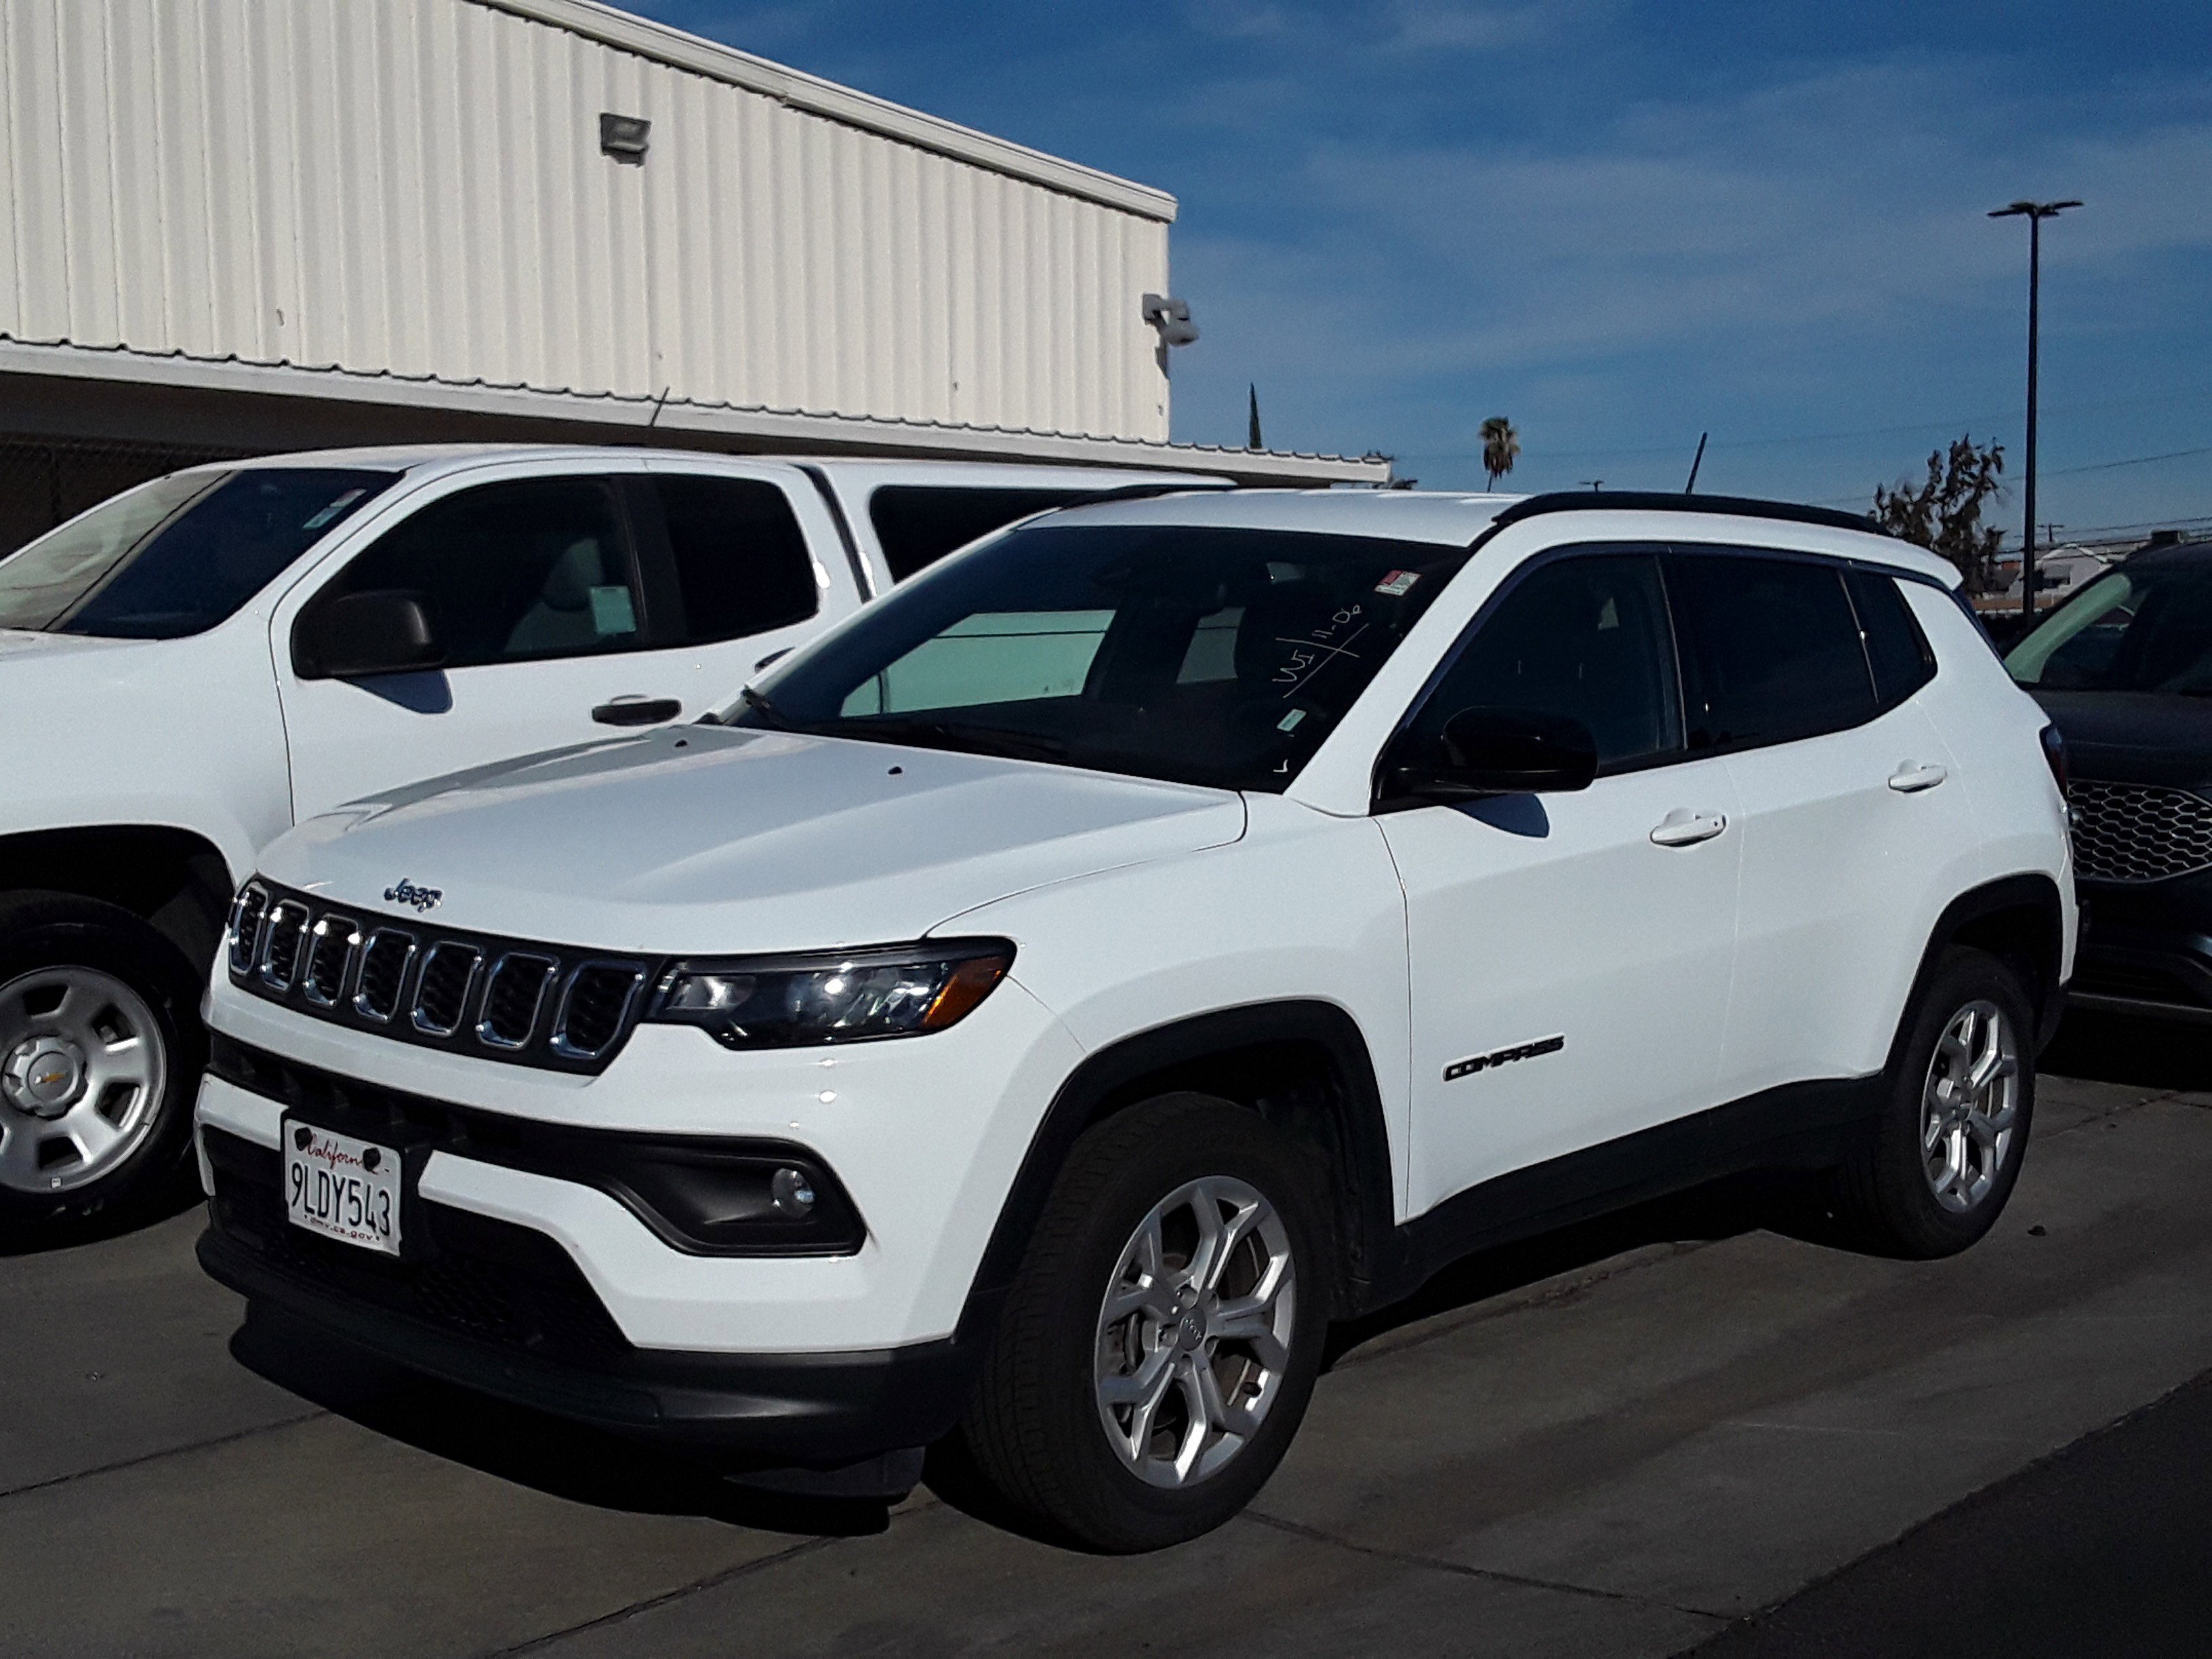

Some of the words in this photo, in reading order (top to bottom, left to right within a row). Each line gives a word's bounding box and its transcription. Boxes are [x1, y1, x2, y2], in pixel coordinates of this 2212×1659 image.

[384, 878, 443, 912] Jeep
[307, 1130, 378, 1175] Californ
[291, 1161, 390, 1237] 9LDY543
